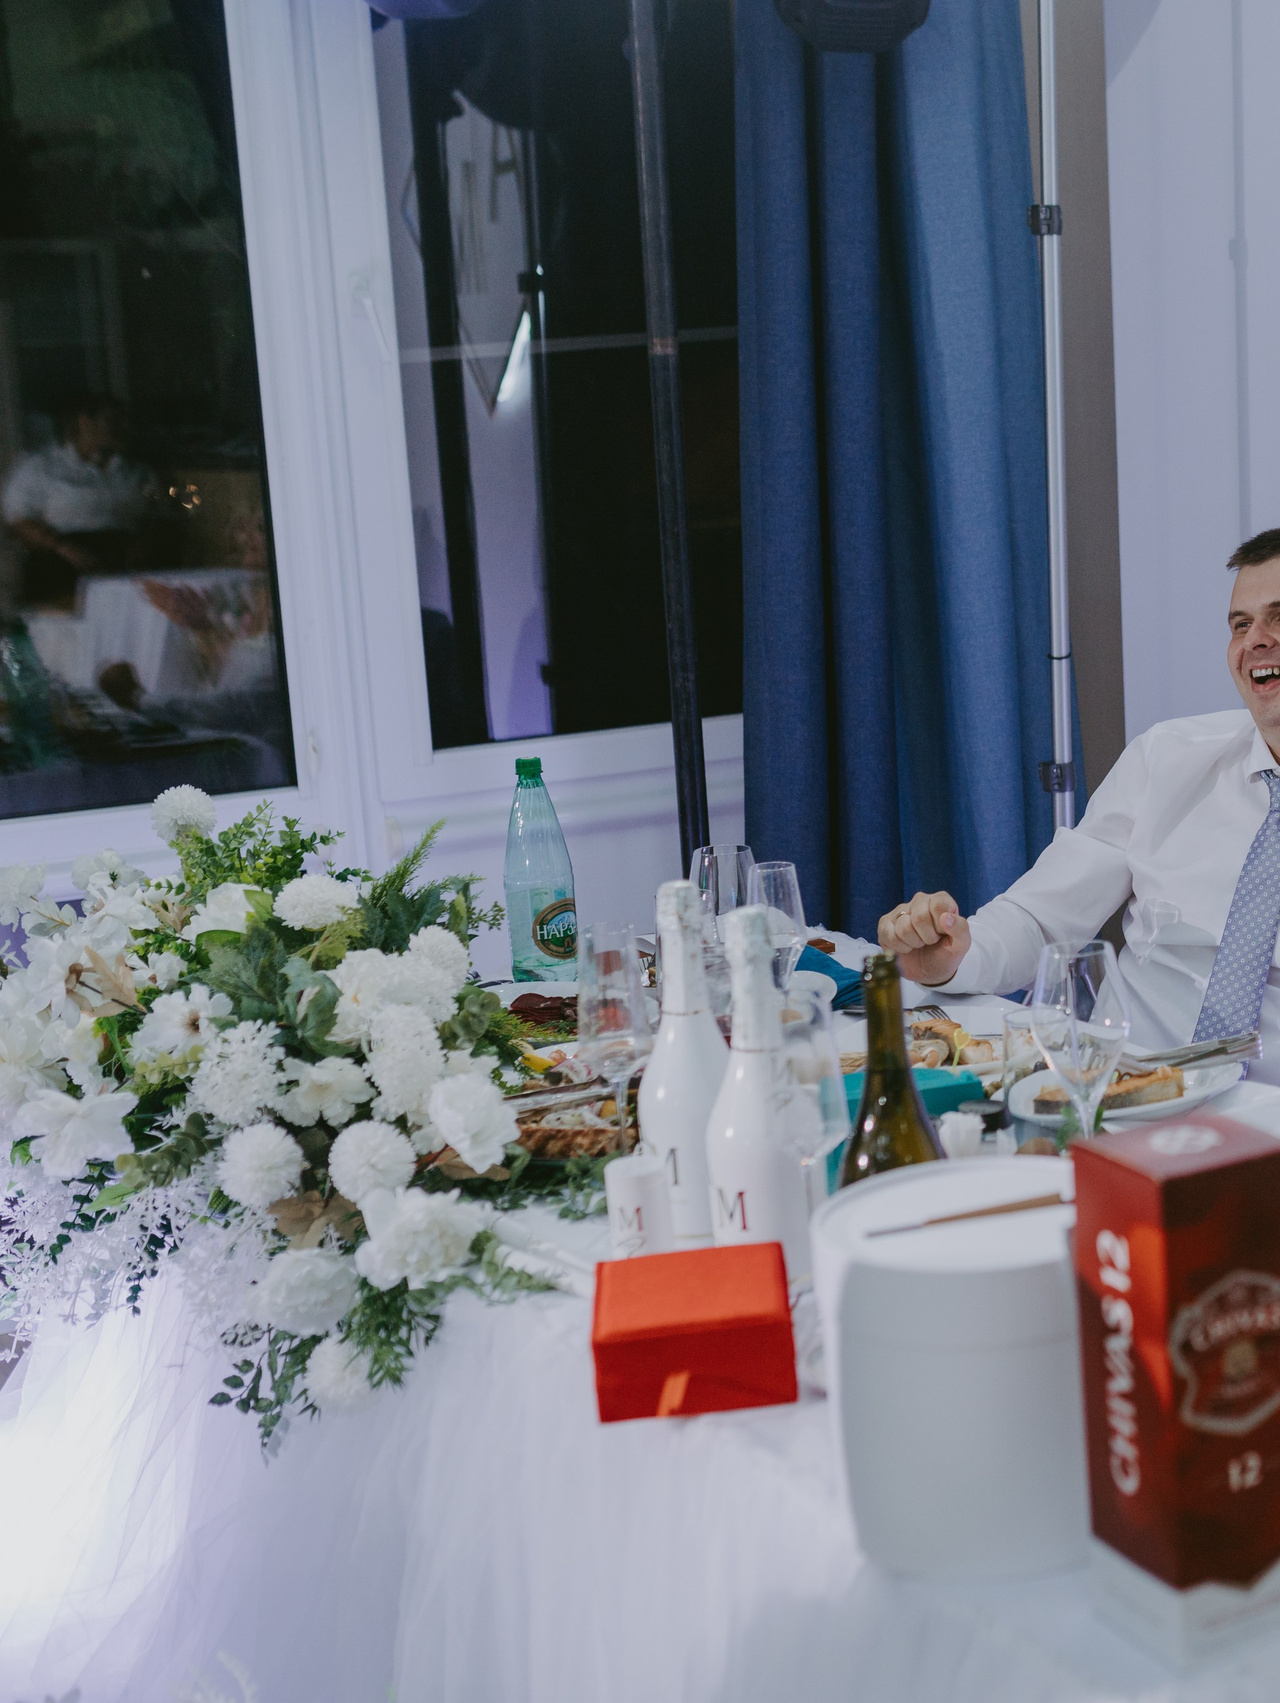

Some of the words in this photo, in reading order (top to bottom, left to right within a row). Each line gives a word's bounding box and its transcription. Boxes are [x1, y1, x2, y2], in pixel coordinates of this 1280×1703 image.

[536, 921, 577, 940] НАРЗ
[618, 1206, 644, 1232] M
[717, 1188, 748, 1231] M
[1096, 1229, 1131, 1292] 12
[1102, 1296, 1140, 1495] CHIVAS
[1228, 1451, 1262, 1493] 12
